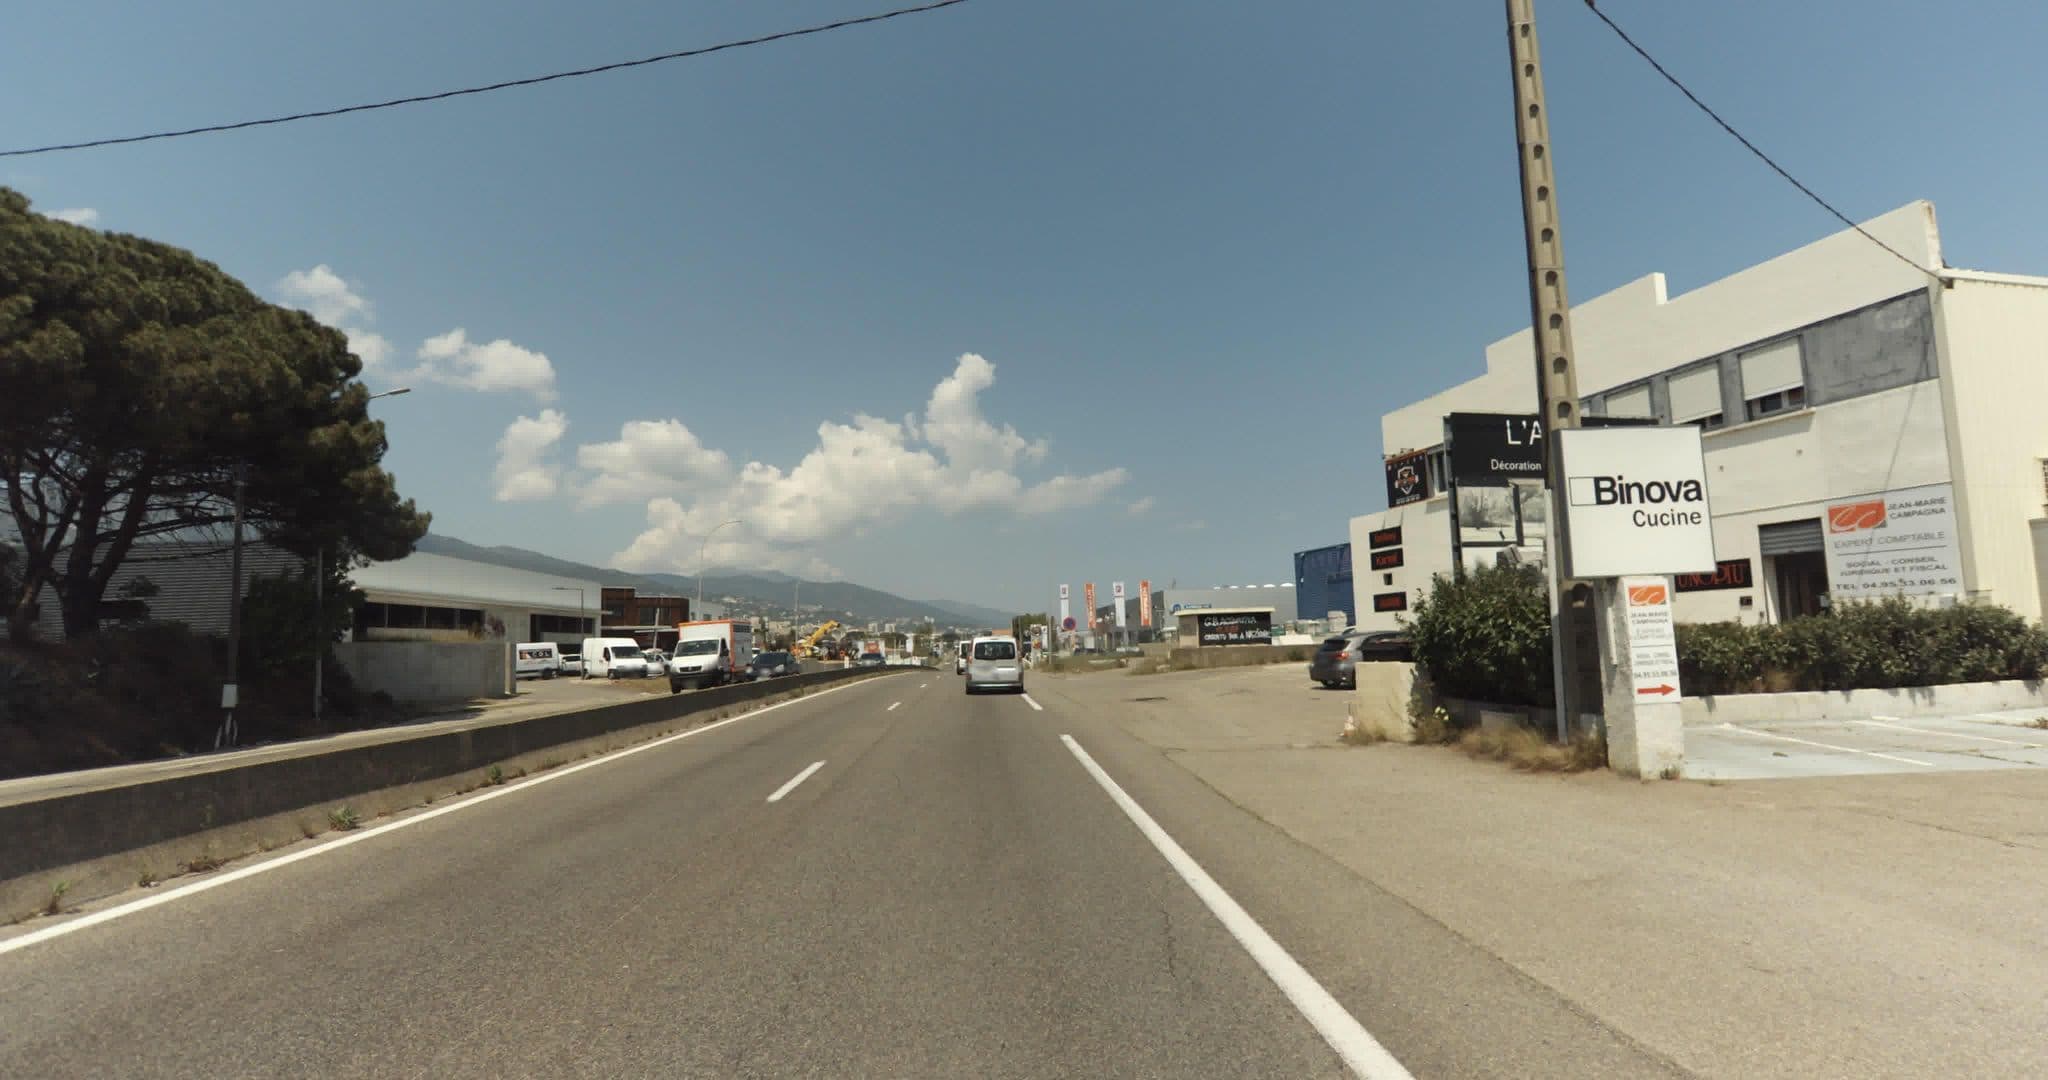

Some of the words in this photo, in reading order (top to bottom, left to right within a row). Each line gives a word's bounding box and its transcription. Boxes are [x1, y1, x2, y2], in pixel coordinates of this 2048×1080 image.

[1490, 458, 1542, 471] Décoration
[1593, 475, 1702, 506] Binova
[1632, 508, 1702, 528] Cucine
[1889, 507, 1946, 520] CAMPAGNA
[1833, 537, 1873, 549] EXPERT
[1878, 531, 1945, 545] COMPTABLE
